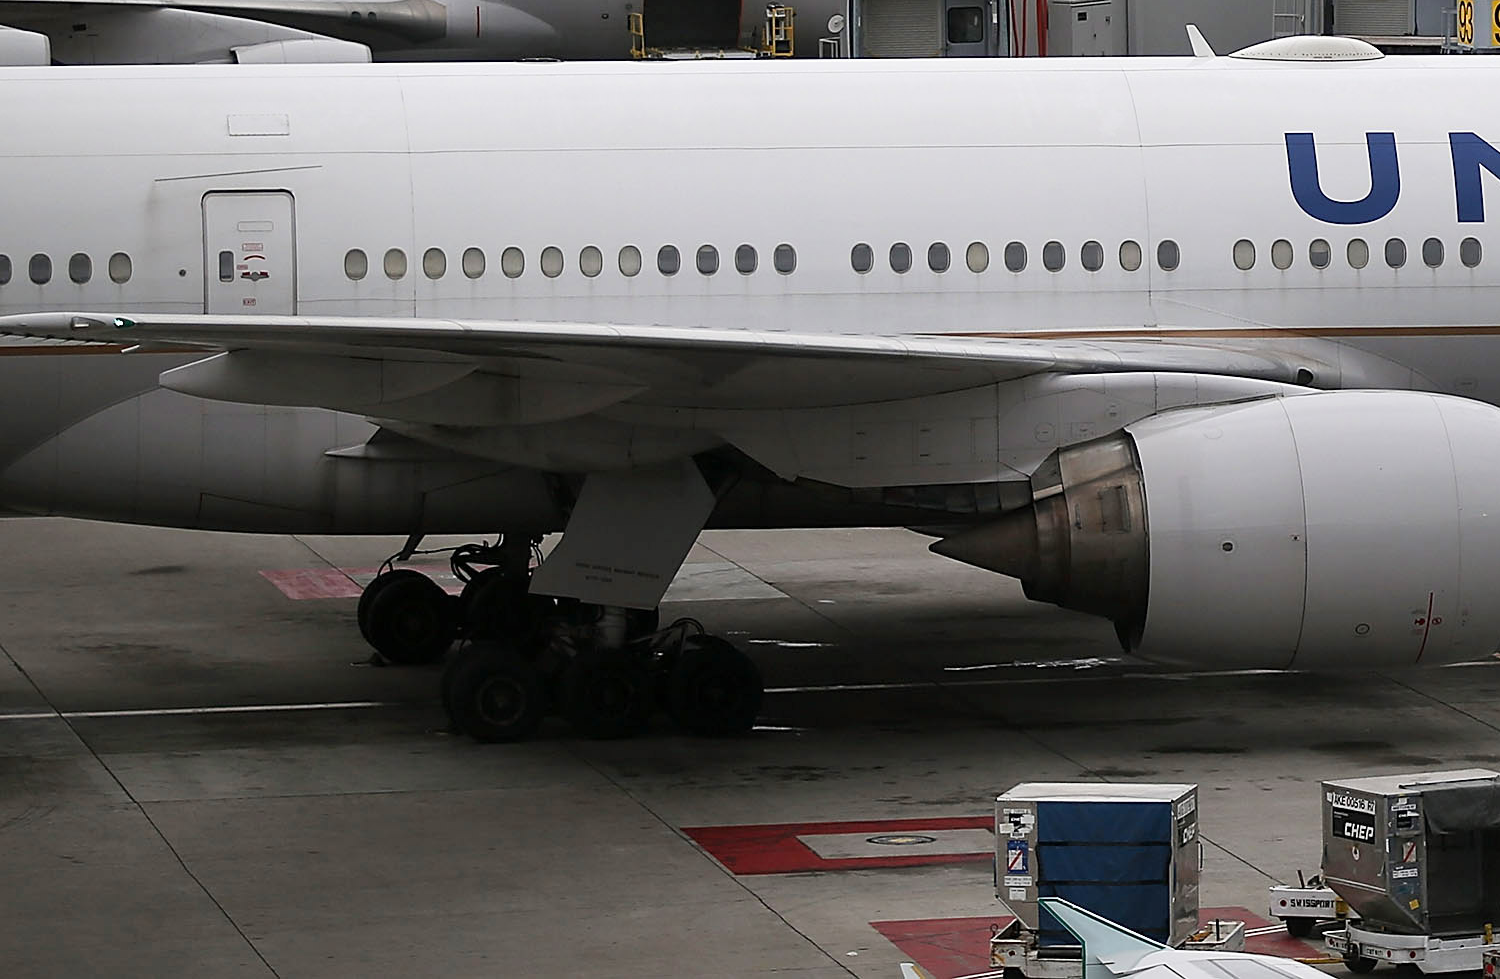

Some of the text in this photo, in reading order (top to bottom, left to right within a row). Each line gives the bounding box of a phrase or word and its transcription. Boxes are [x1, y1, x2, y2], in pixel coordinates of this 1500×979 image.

[1459, 0, 1474, 44] 93
[1344, 822, 1374, 841] CHEP
[1290, 899, 1334, 909] SWISSPORT
